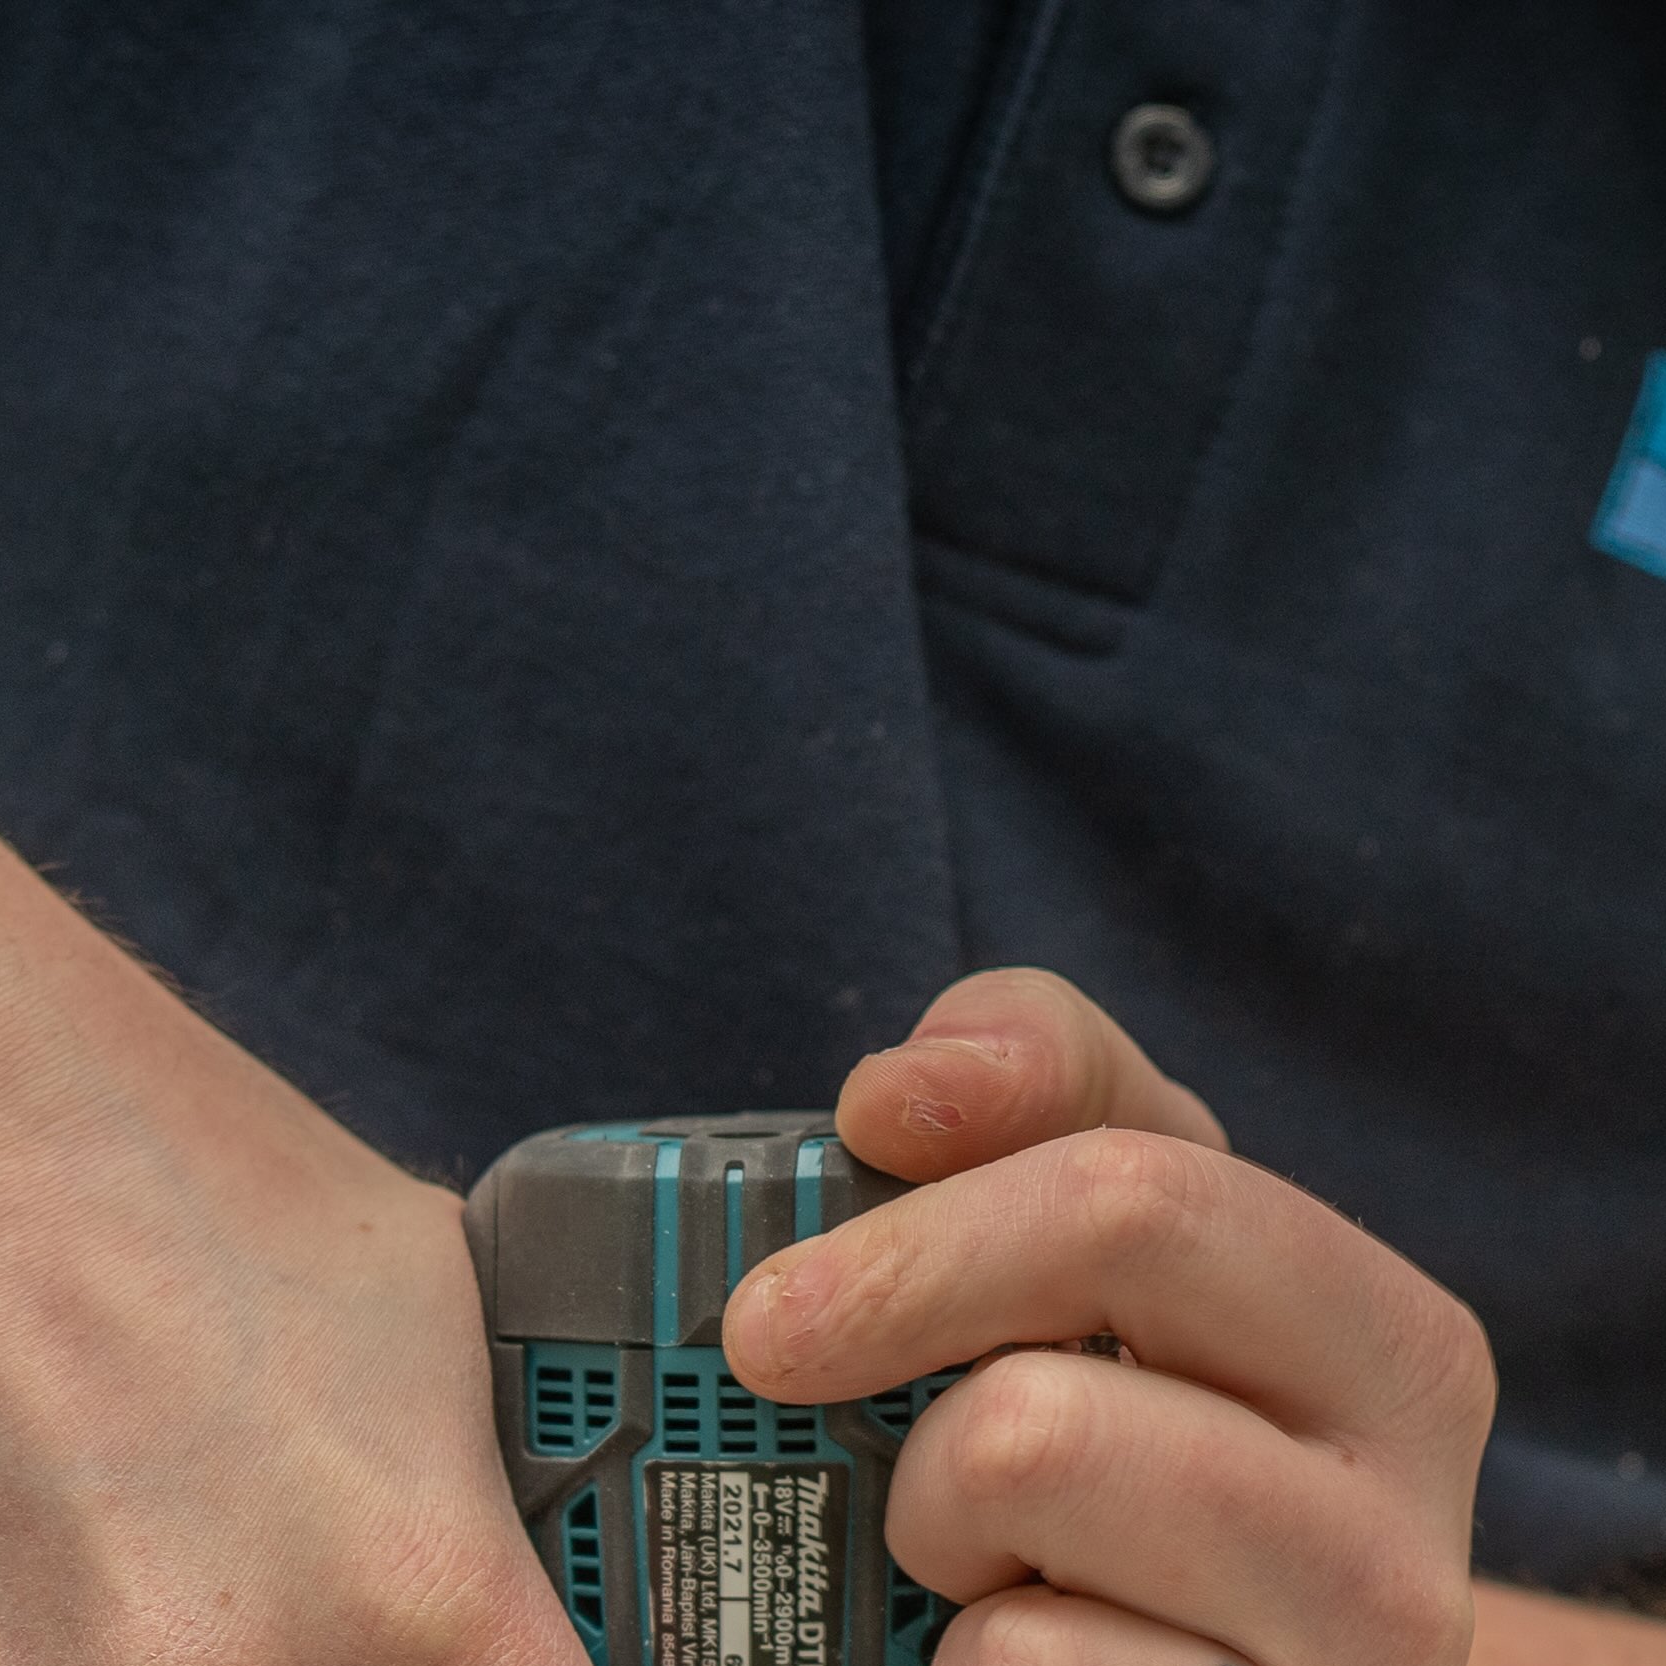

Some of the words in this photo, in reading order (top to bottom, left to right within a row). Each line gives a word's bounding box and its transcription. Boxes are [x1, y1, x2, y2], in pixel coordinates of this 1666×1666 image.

[660, 1471, 676, 1517] Made
[678, 1472, 696, 1535] Makita,
[700, 1472, 717, 1530] Makita
[661, 1521, 676, 1542] in
[697, 1535, 717, 1575] (UK)
[722, 1484, 743, 1573] 2021.7
[796, 1472, 829, 1619] Makita
[661, 1546, 676, 1624] Romania
[678, 1540, 696, 1639] Jan-Baptist
[698, 1580, 717, 1613] Ltd,
